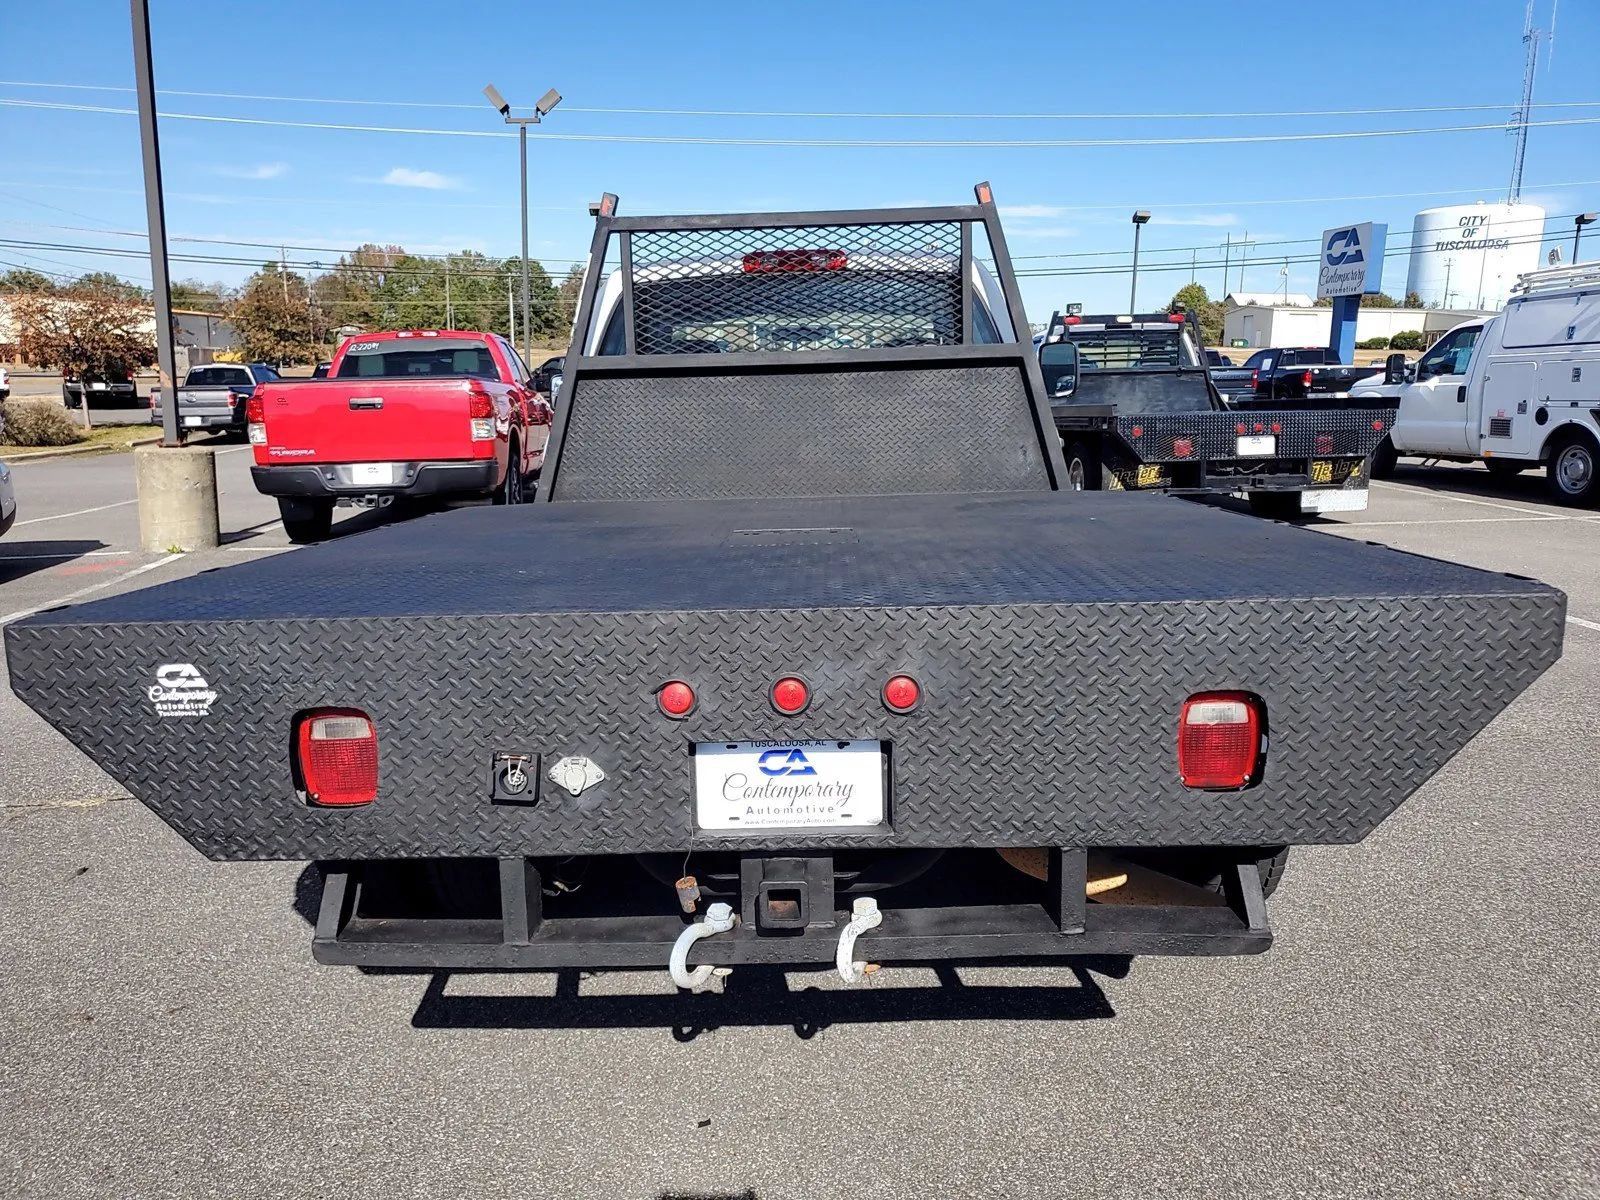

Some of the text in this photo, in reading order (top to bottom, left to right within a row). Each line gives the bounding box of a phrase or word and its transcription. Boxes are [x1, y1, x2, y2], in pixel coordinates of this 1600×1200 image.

[1459, 216, 1487, 226] CITY
[1462, 228, 1479, 238] OF
[1435, 240, 1509, 251] TUSCALOOSA
[1320, 266, 1365, 288] Contemporary
[722, 772, 854, 807] Contemporary
[746, 805, 834, 815] Automotive
